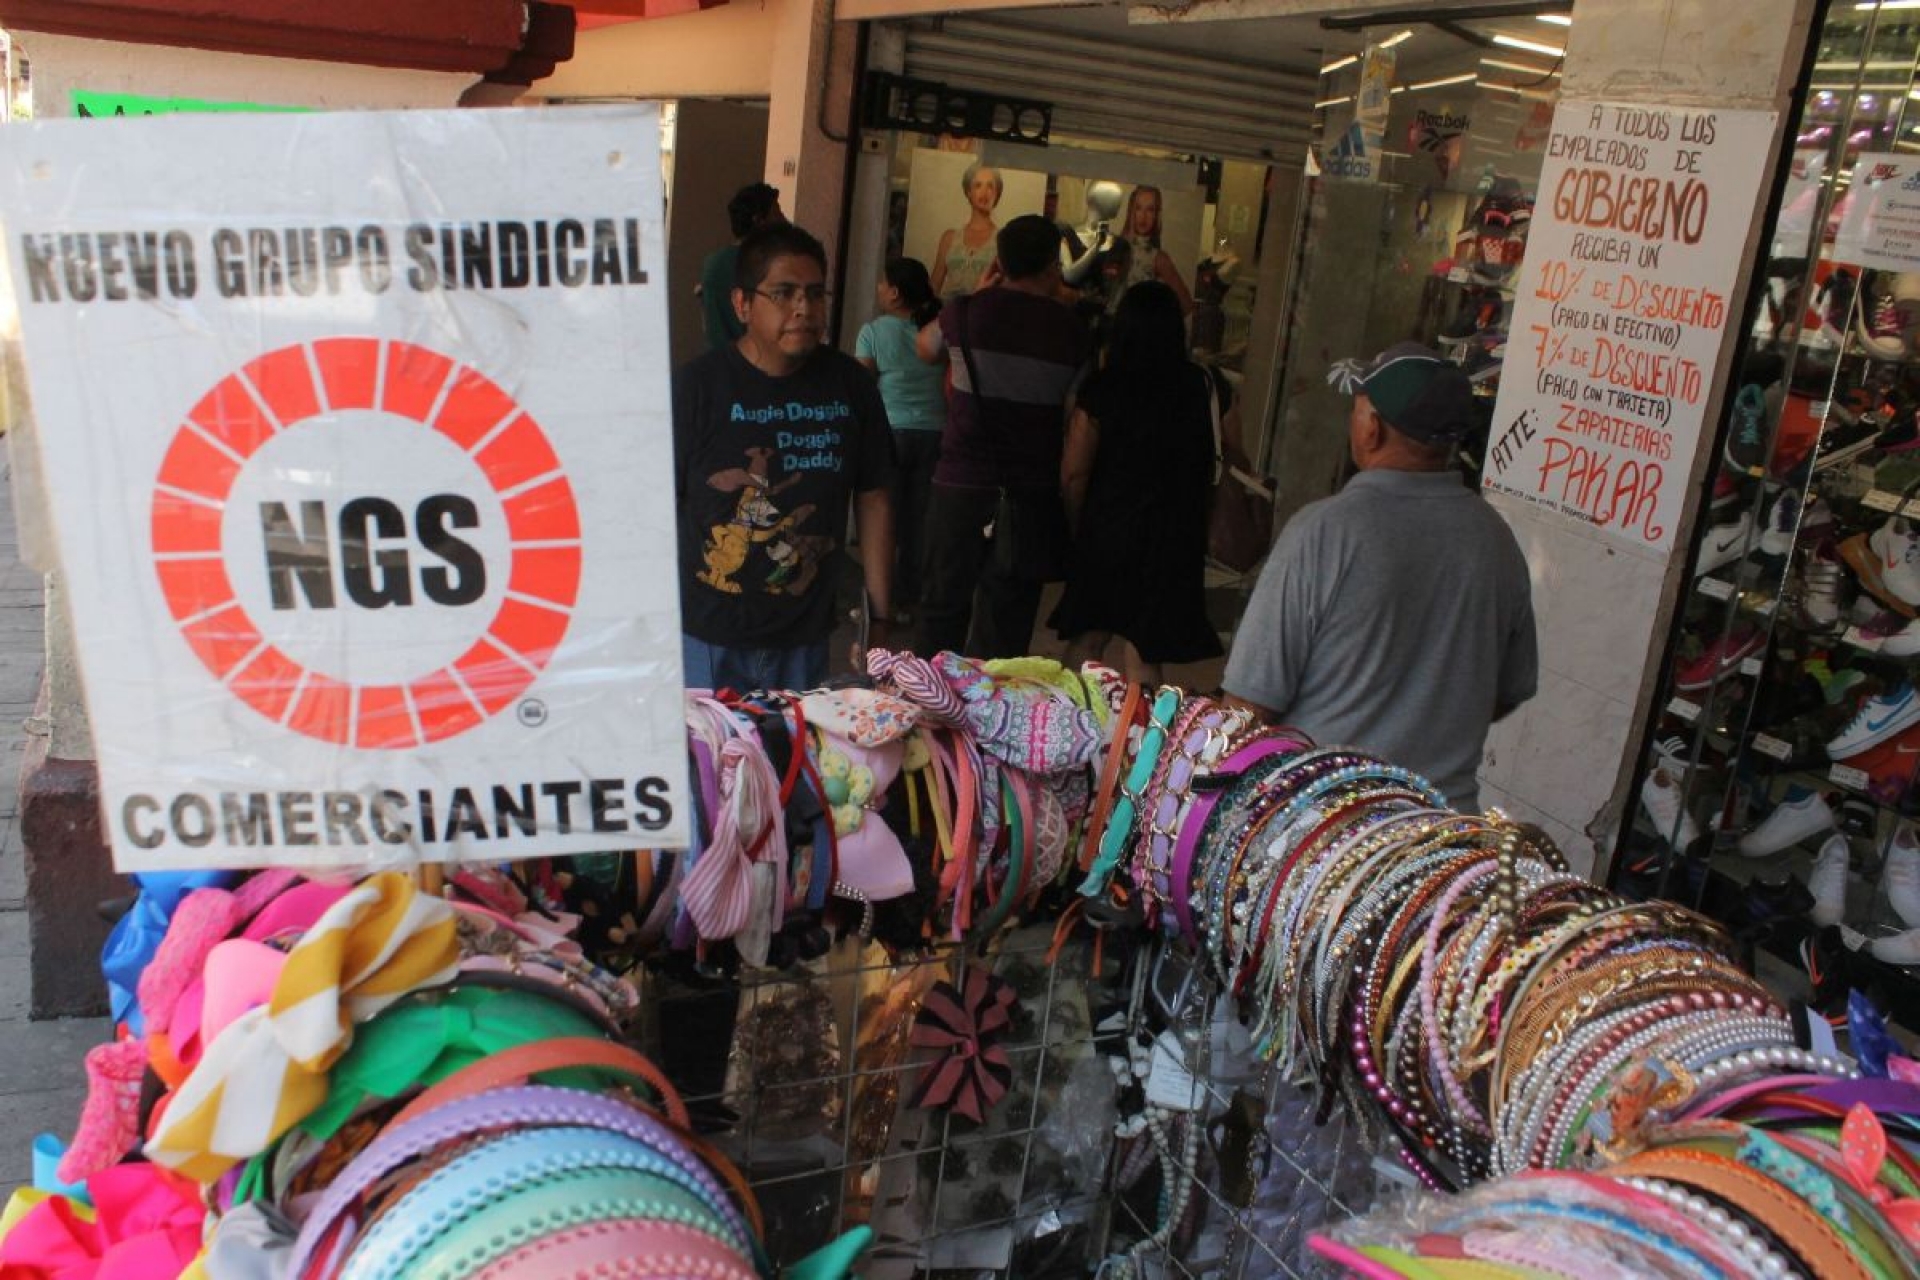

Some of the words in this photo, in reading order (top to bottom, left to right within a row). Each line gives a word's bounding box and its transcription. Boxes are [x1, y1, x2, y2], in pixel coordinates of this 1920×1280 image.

[1549, 133, 1648, 172] EMPLEADOS
[1674, 150, 1702, 173] DE
[1588, 104, 1603, 130] A
[1616, 107, 1671, 142] TODOS
[1680, 114, 1717, 145] LOS
[1553, 167, 1709, 245] GOBIERNO
[21, 230, 197, 302] NUEVO
[210, 222, 390, 299] GRUPO
[405, 217, 649, 291] SINDICAL
[1570, 233, 1631, 265] RECIBA
[1637, 244, 1662, 269] UN
[1534, 261, 1586, 301] 10%
[1593, 279, 1614, 300] DE
[1611, 274, 1725, 328] DESCUENTO
[1551, 304, 1589, 329] (PAGO
[1592, 314, 1608, 332] EN
[1614, 316, 1682, 350] EFECTIVO)
[1531, 325, 1569, 369] 7%
[1570, 347, 1588, 367] DE
[1589, 338, 1702, 405] DESCUENTO
[1537, 368, 1579, 401] (PAGO
[1583, 384, 1603, 403] CON
[730, 403, 785, 424] Augie
[786, 401, 849, 422] Doggie
[776, 429, 841, 450] Doggie
[1490, 407, 1539, 475] ATTE:
[1556, 404, 1673, 461] ZAPATERIAS
[783, 451, 843, 472] Daddy
[1538, 437, 1664, 541] PAKAR
[258, 493, 487, 611] NGS
[121, 774, 674, 851] COMERCIANTES
